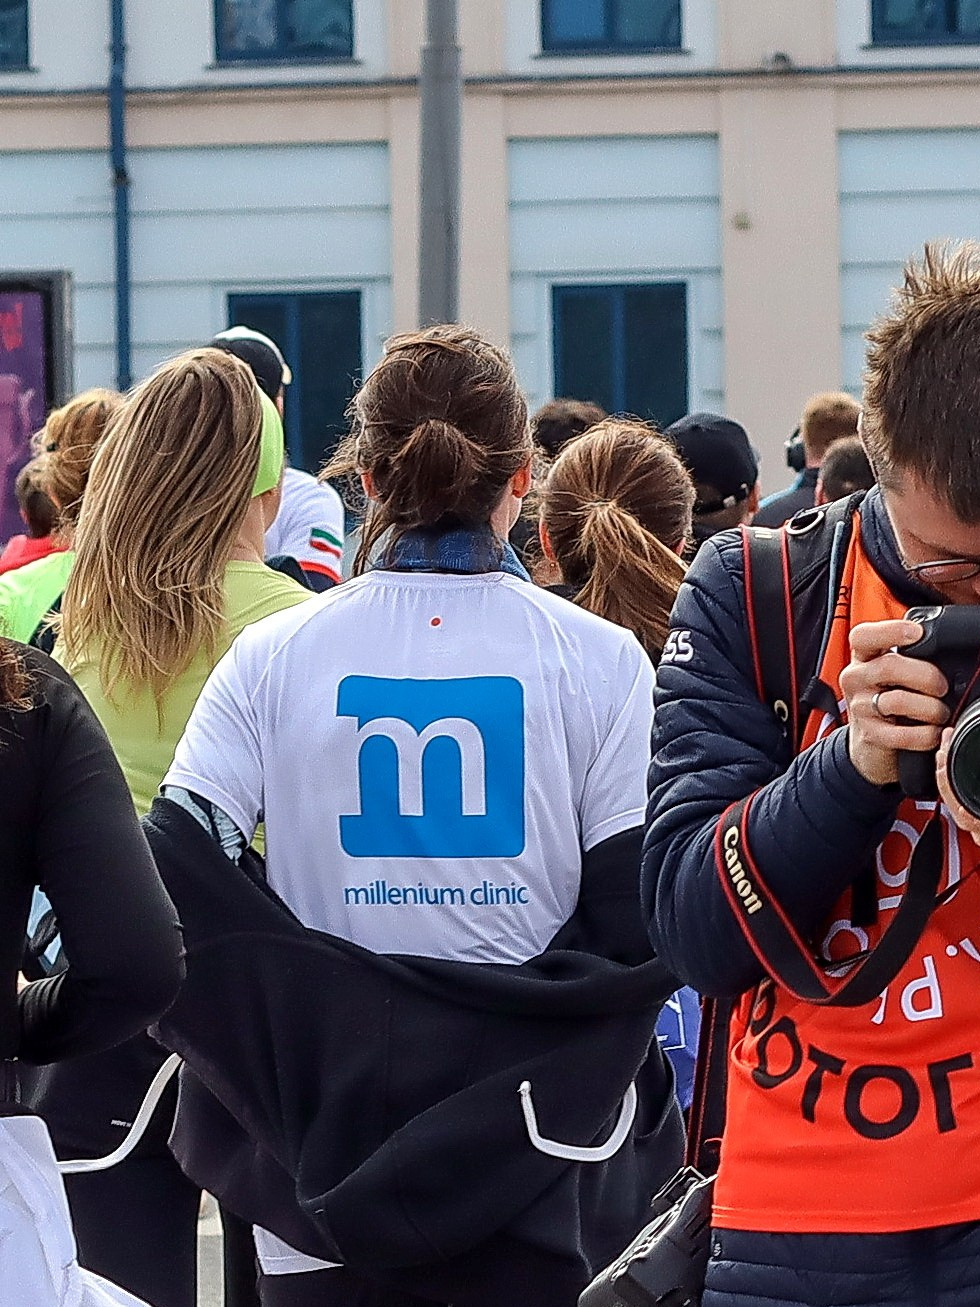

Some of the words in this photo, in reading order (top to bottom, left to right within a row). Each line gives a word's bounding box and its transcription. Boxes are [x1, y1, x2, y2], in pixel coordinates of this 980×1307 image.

[344, 881, 466, 906] millenium
[470, 881, 529, 905] clinic
[724, 825, 763, 915] Canon
